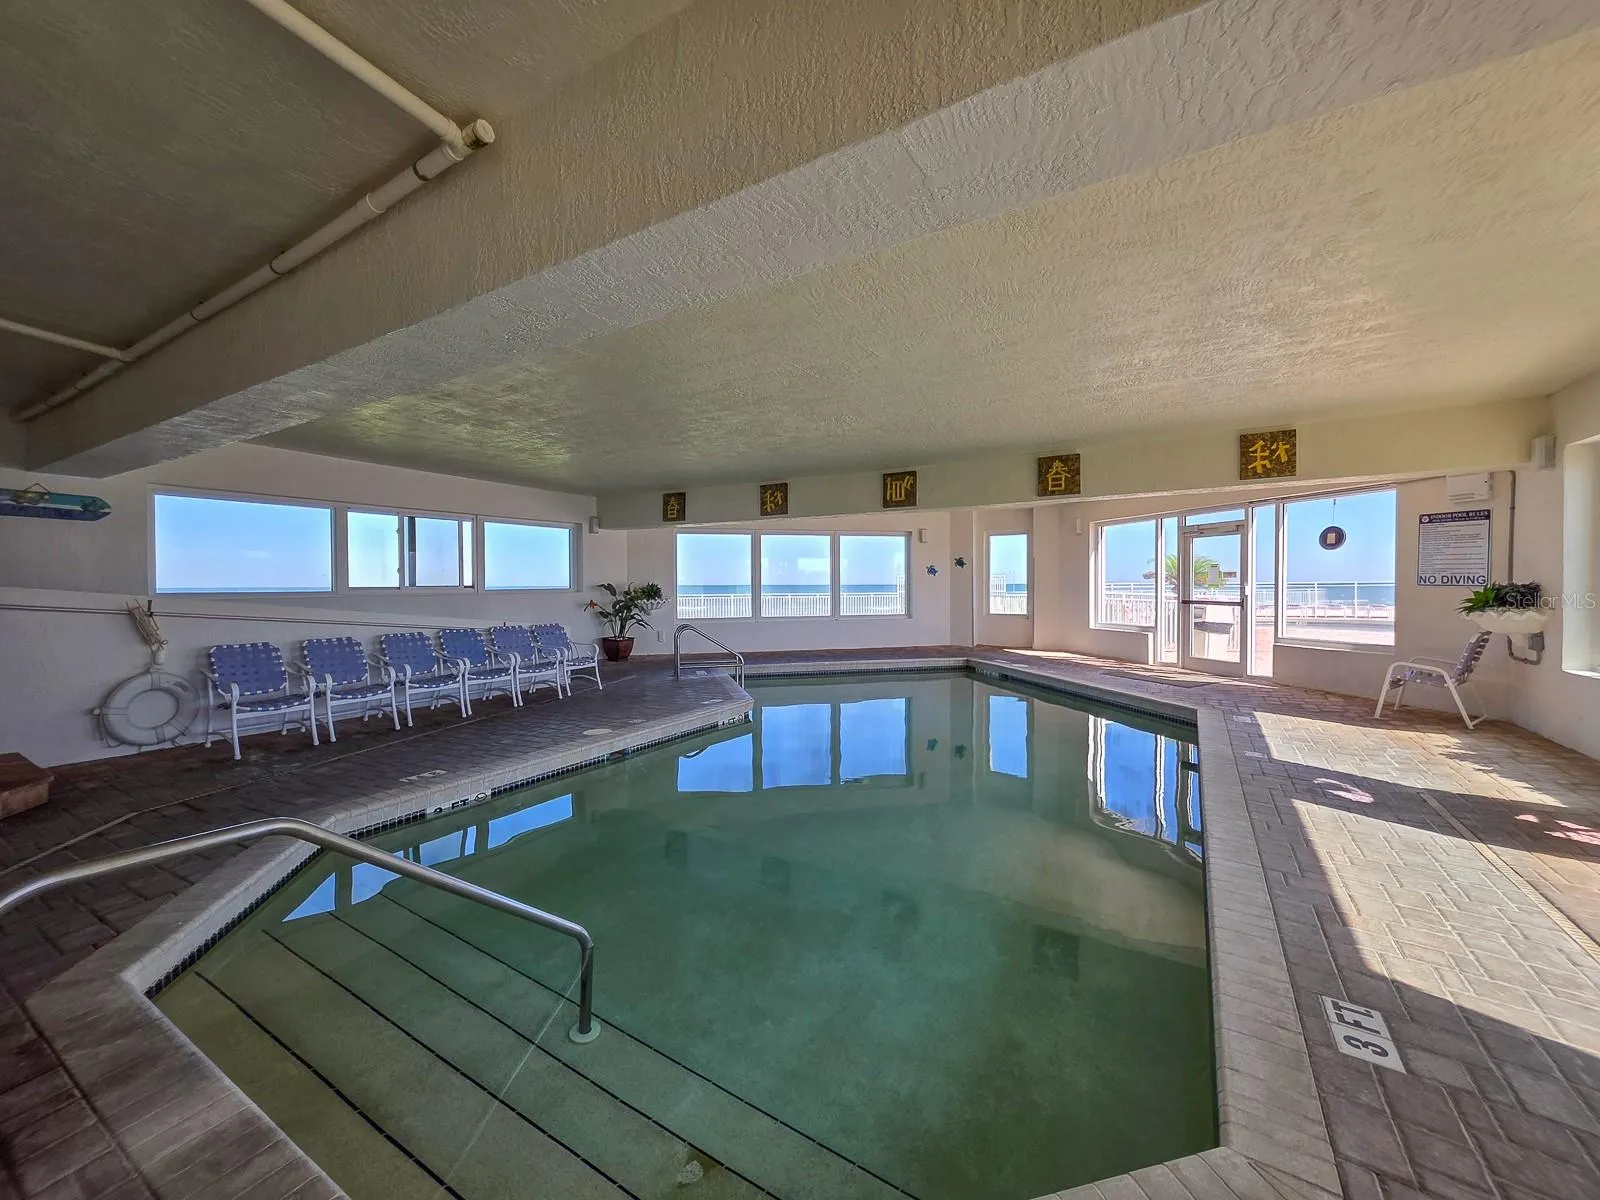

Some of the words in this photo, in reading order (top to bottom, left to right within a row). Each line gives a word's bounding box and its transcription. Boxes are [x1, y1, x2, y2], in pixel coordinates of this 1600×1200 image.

[1419, 575, 1437, 584] NO
[1441, 575, 1486, 584] DIVING
[1343, 1035, 1389, 1058] 3
